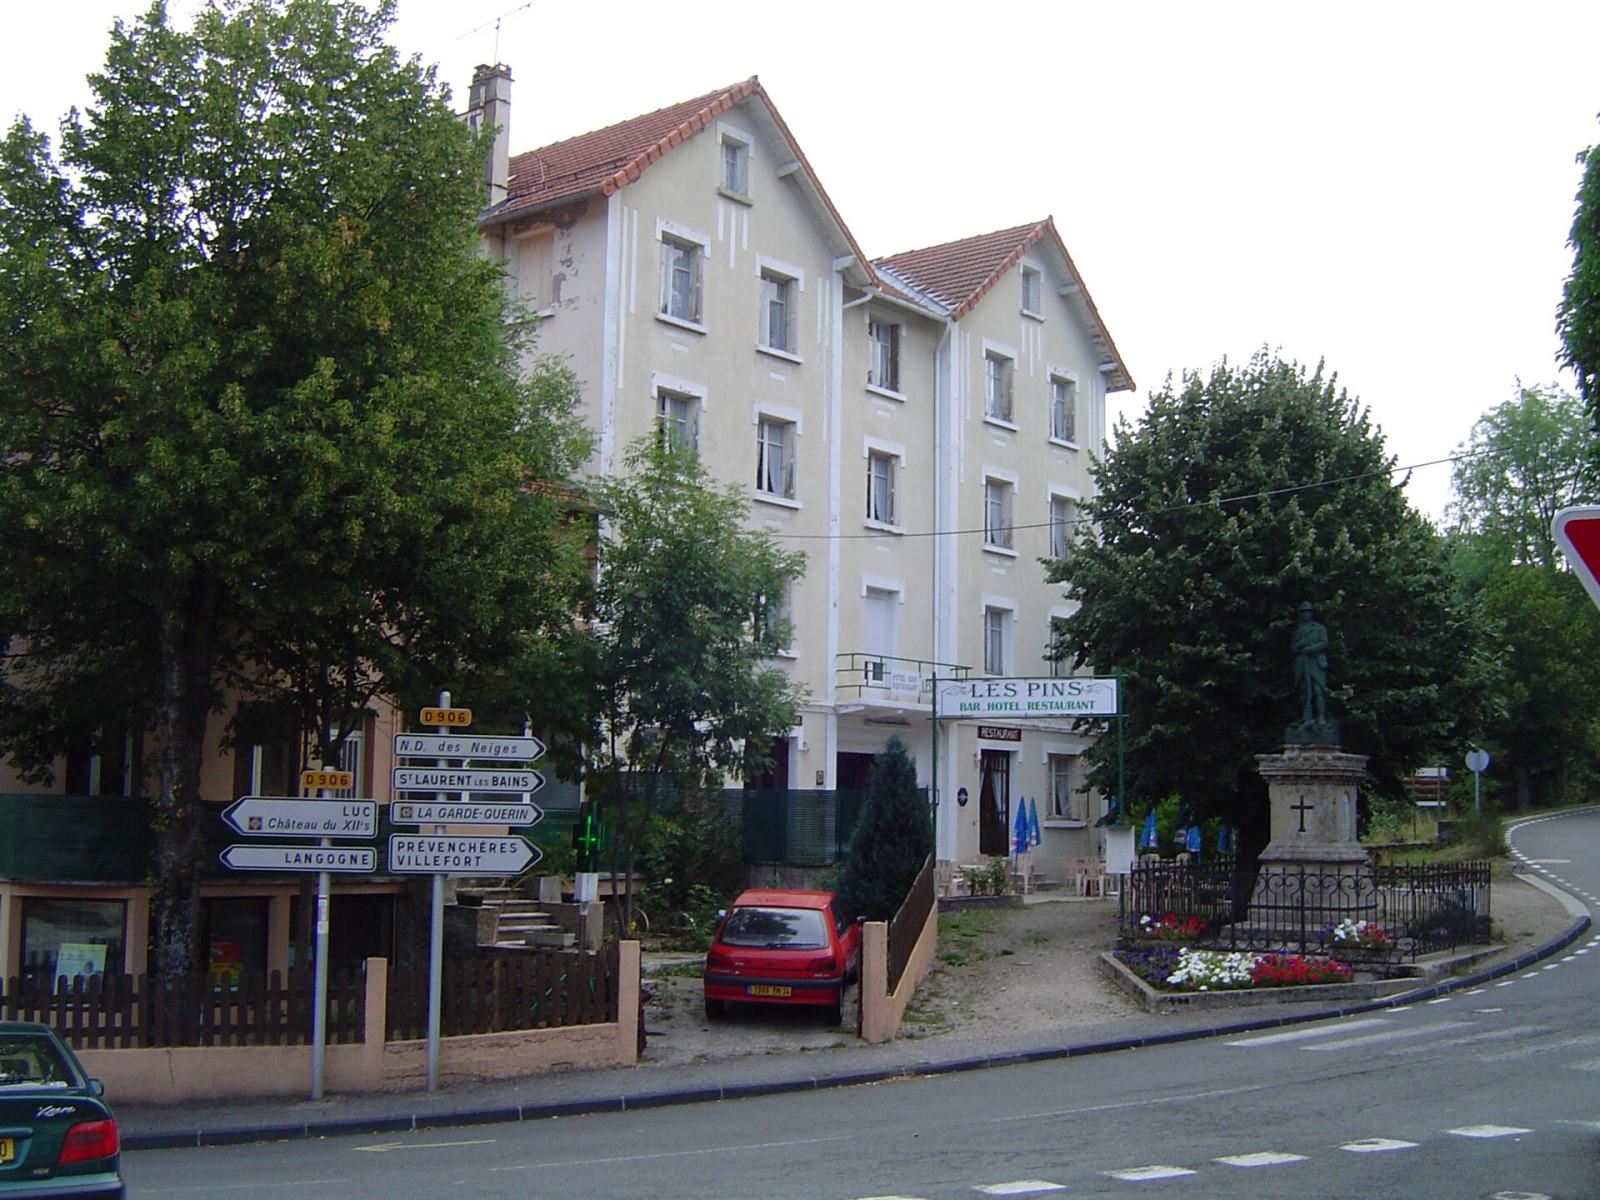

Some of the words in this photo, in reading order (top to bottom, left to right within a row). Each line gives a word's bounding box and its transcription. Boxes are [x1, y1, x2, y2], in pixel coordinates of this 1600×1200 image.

[970, 682, 1017, 698] LES
[1027, 681, 1082, 697] PINS
[959, 702, 981, 712] BAR
[987, 701, 1020, 711] HOTEL
[1027, 700, 1096, 711] RESTAURANT
[425, 711, 433, 722] D
[437, 711, 466, 723] 906
[981, 727, 1020, 740] RESTAURANT
[400, 740, 426, 752] N.D.
[438, 741, 461, 753] des
[471, 742, 518, 756] Neiges
[306, 774, 314, 785] D
[318, 774, 348, 785] 906
[415, 774, 472, 786] LAURENT
[474, 777, 489, 786] LES
[492, 776, 529, 787] BAINS
[342, 806, 371, 817] LUC
[417, 807, 433, 818] LA
[438, 807, 529, 820] GARDE-GUERIN
[267, 817, 318, 830] Château
[323, 819, 337, 830] du
[285, 853, 370, 865] LANGOGNE
[397, 855, 481, 867] VILLEFORT
